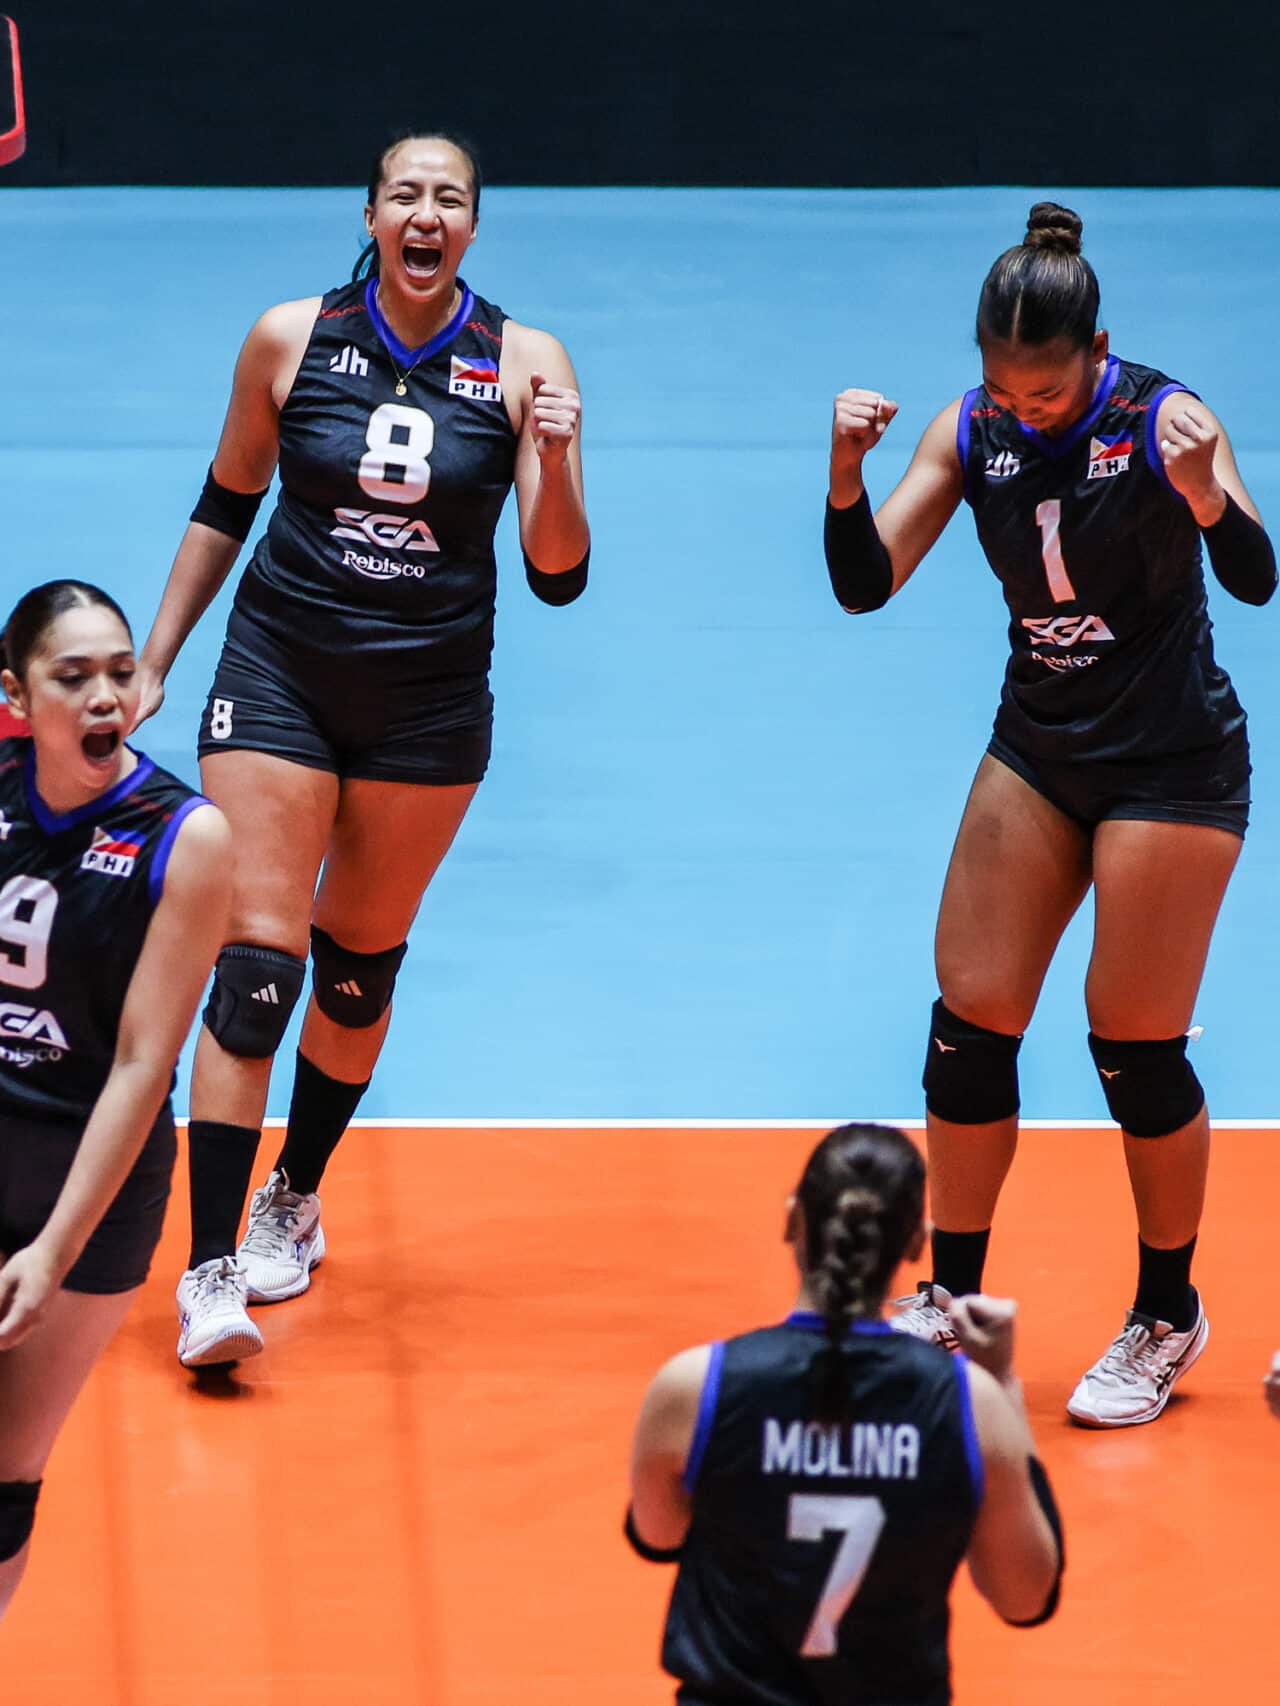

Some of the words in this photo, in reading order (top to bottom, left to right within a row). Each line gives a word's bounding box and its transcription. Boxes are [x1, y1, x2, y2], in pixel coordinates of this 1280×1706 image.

[454, 382, 497, 399] PHI
[357, 403, 435, 504] 8
[329, 507, 441, 551] SGA
[1035, 499, 1077, 603] 1
[341, 550, 426, 580] Rebisco
[210, 698, 234, 740] 8
[87, 853, 129, 873] PHI
[762, 1418, 920, 1480] MOLINA
[786, 1492, 887, 1657] 7
